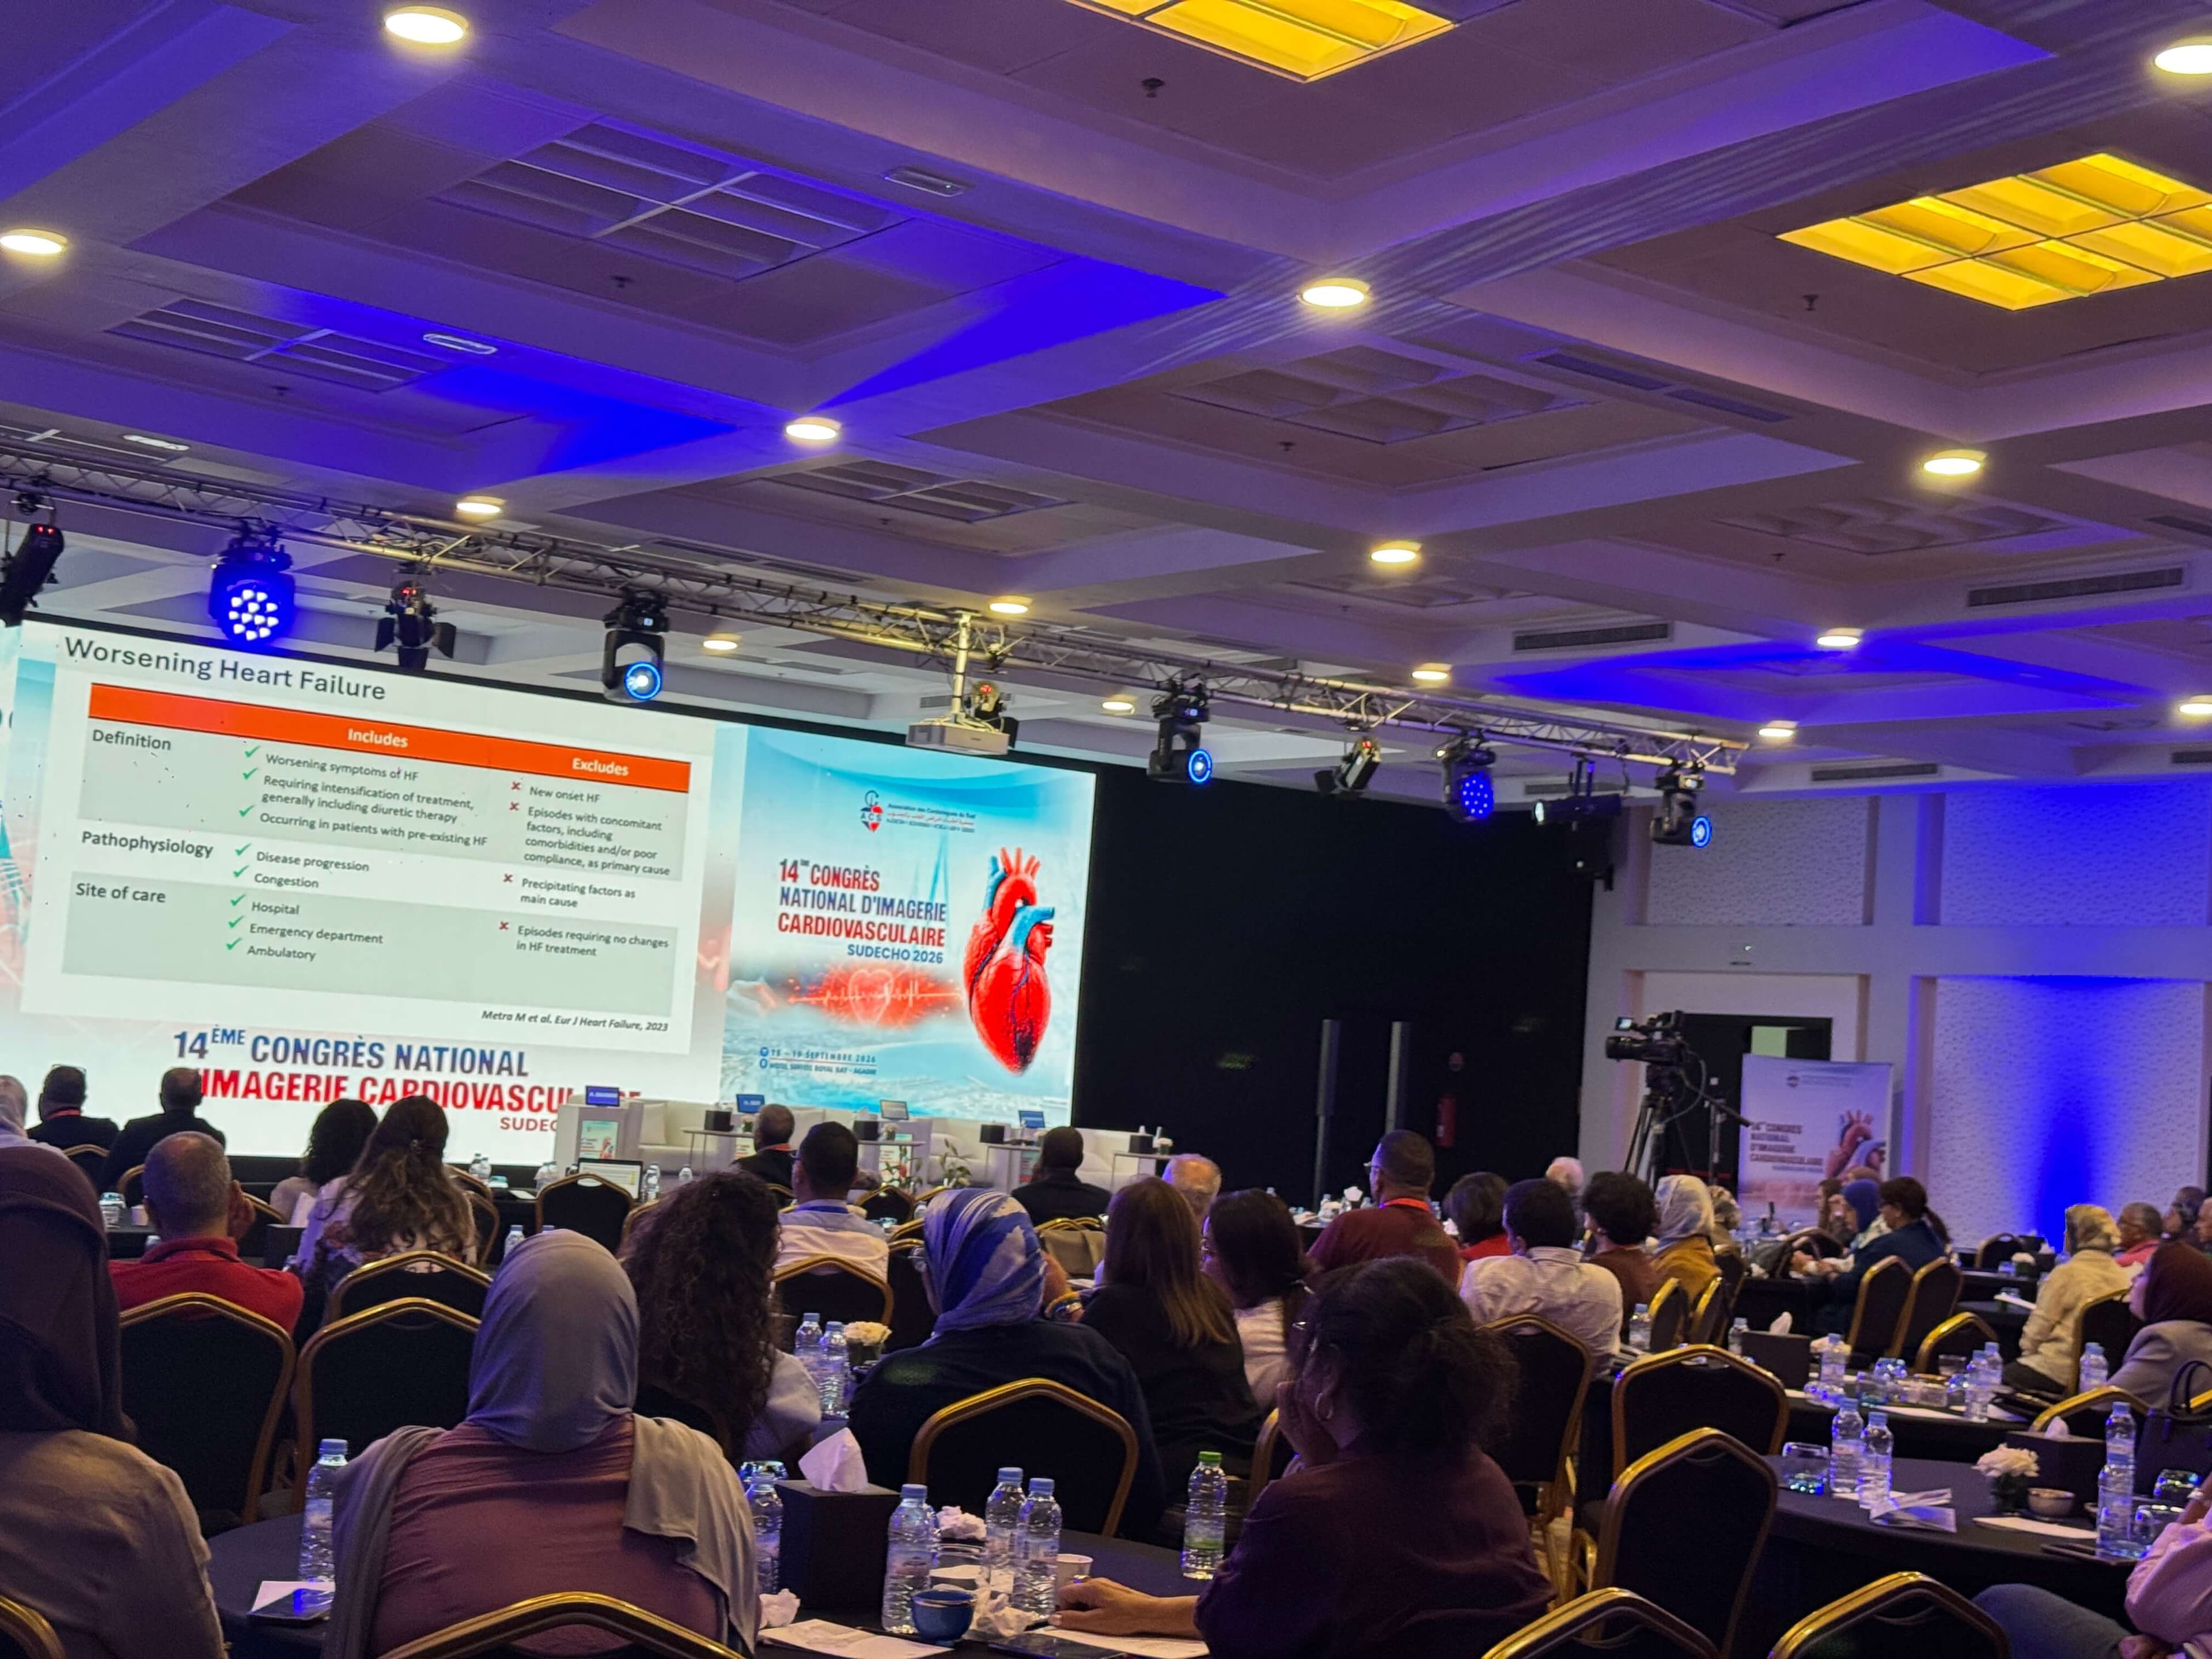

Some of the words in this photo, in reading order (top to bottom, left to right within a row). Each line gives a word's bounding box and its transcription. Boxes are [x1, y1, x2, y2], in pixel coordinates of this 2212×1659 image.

[66, 637, 213, 680] Worsening
[219, 660, 292, 687] Heart
[301, 671, 386, 699] Failure
[93, 729, 171, 750] Definition
[348, 728, 408, 748] Includes
[266, 753, 327, 772] Worsening
[330, 764, 387, 777] symptoms
[389, 767, 401, 778] of
[404, 771, 419, 781] HF
[572, 758, 629, 776] Excludes
[264, 775, 319, 793] Requiring
[321, 782, 399, 800] intensification
[403, 793, 415, 801] of
[417, 795, 474, 810] treatment,
[530, 786, 552, 797] New
[555, 790, 584, 801] onset
[586, 794, 600, 802] HF
[262, 793, 315, 808] generally
[318, 797, 368, 814] including
[371, 804, 414, 817] diuretic
[416, 809, 458, 824] therapy
[528, 806, 573, 820] Episodes
[576, 813, 597, 823] with
[600, 817, 662, 830] concomitant
[260, 812, 316, 830] Occurring
[319, 818, 329, 829] in
[332, 822, 378, 835] patients
[380, 827, 405, 838] with
[408, 831, 471, 846] pre-existing
[473, 836, 488, 846] HF
[527, 821, 565, 835] factors,
[567, 825, 613, 841] including
[82, 831, 213, 858] Pathophysiology
[525, 838, 595, 853] comorbidities
[597, 845, 631, 857] and/or
[634, 850, 658, 860] poor
[257, 851, 301, 865] Disease
[304, 858, 369, 872] progression
[524, 853, 585, 868] compliance,
[601, 861, 639, 873] primary
[642, 865, 671, 876] cause
[255, 873, 319, 888] Congestion
[522, 878, 586, 895] Precipitating
[588, 884, 622, 896] factors
[810, 864, 880, 892] CONGRÈS
[76, 882, 107, 898] Site
[111, 886, 129, 900] of
[132, 890, 166, 903] care
[521, 895, 546, 904] main
[549, 898, 578, 907] cause
[252, 902, 300, 915] Hospital
[779, 887, 856, 913] NATIONAL
[861, 895, 947, 922] D'IMAGERIE
[250, 923, 313, 940] Emergency
[316, 929, 384, 944] department
[518, 925, 563, 939] Episodes
[566, 931, 611, 945] requiring
[613, 935, 627, 944] no
[629, 935, 669, 949] changes
[778, 912, 945, 947] CARDIOVASCULAIRE
[247, 946, 316, 962] Ambulatory
[516, 940, 527, 950] in
[529, 941, 543, 951] HF
[545, 944, 597, 956] treatment
[847, 944, 911, 961] SUDECHO
[913, 950, 943, 964] 2026
[482, 1010, 513, 1020] Metra
[514, 1013, 526, 1021] M
[528, 1014, 537, 1022] et
[540, 1015, 552, 1024] al.
[555, 1016, 571, 1024] Eur
[579, 1018, 607, 1027] Heart
[608, 1020, 643, 1031] Failure,
[645, 1022, 668, 1032] 2023
[251, 1035, 385, 1069] CONGRÈS
[395, 1044, 528, 1077] NATIONAL
